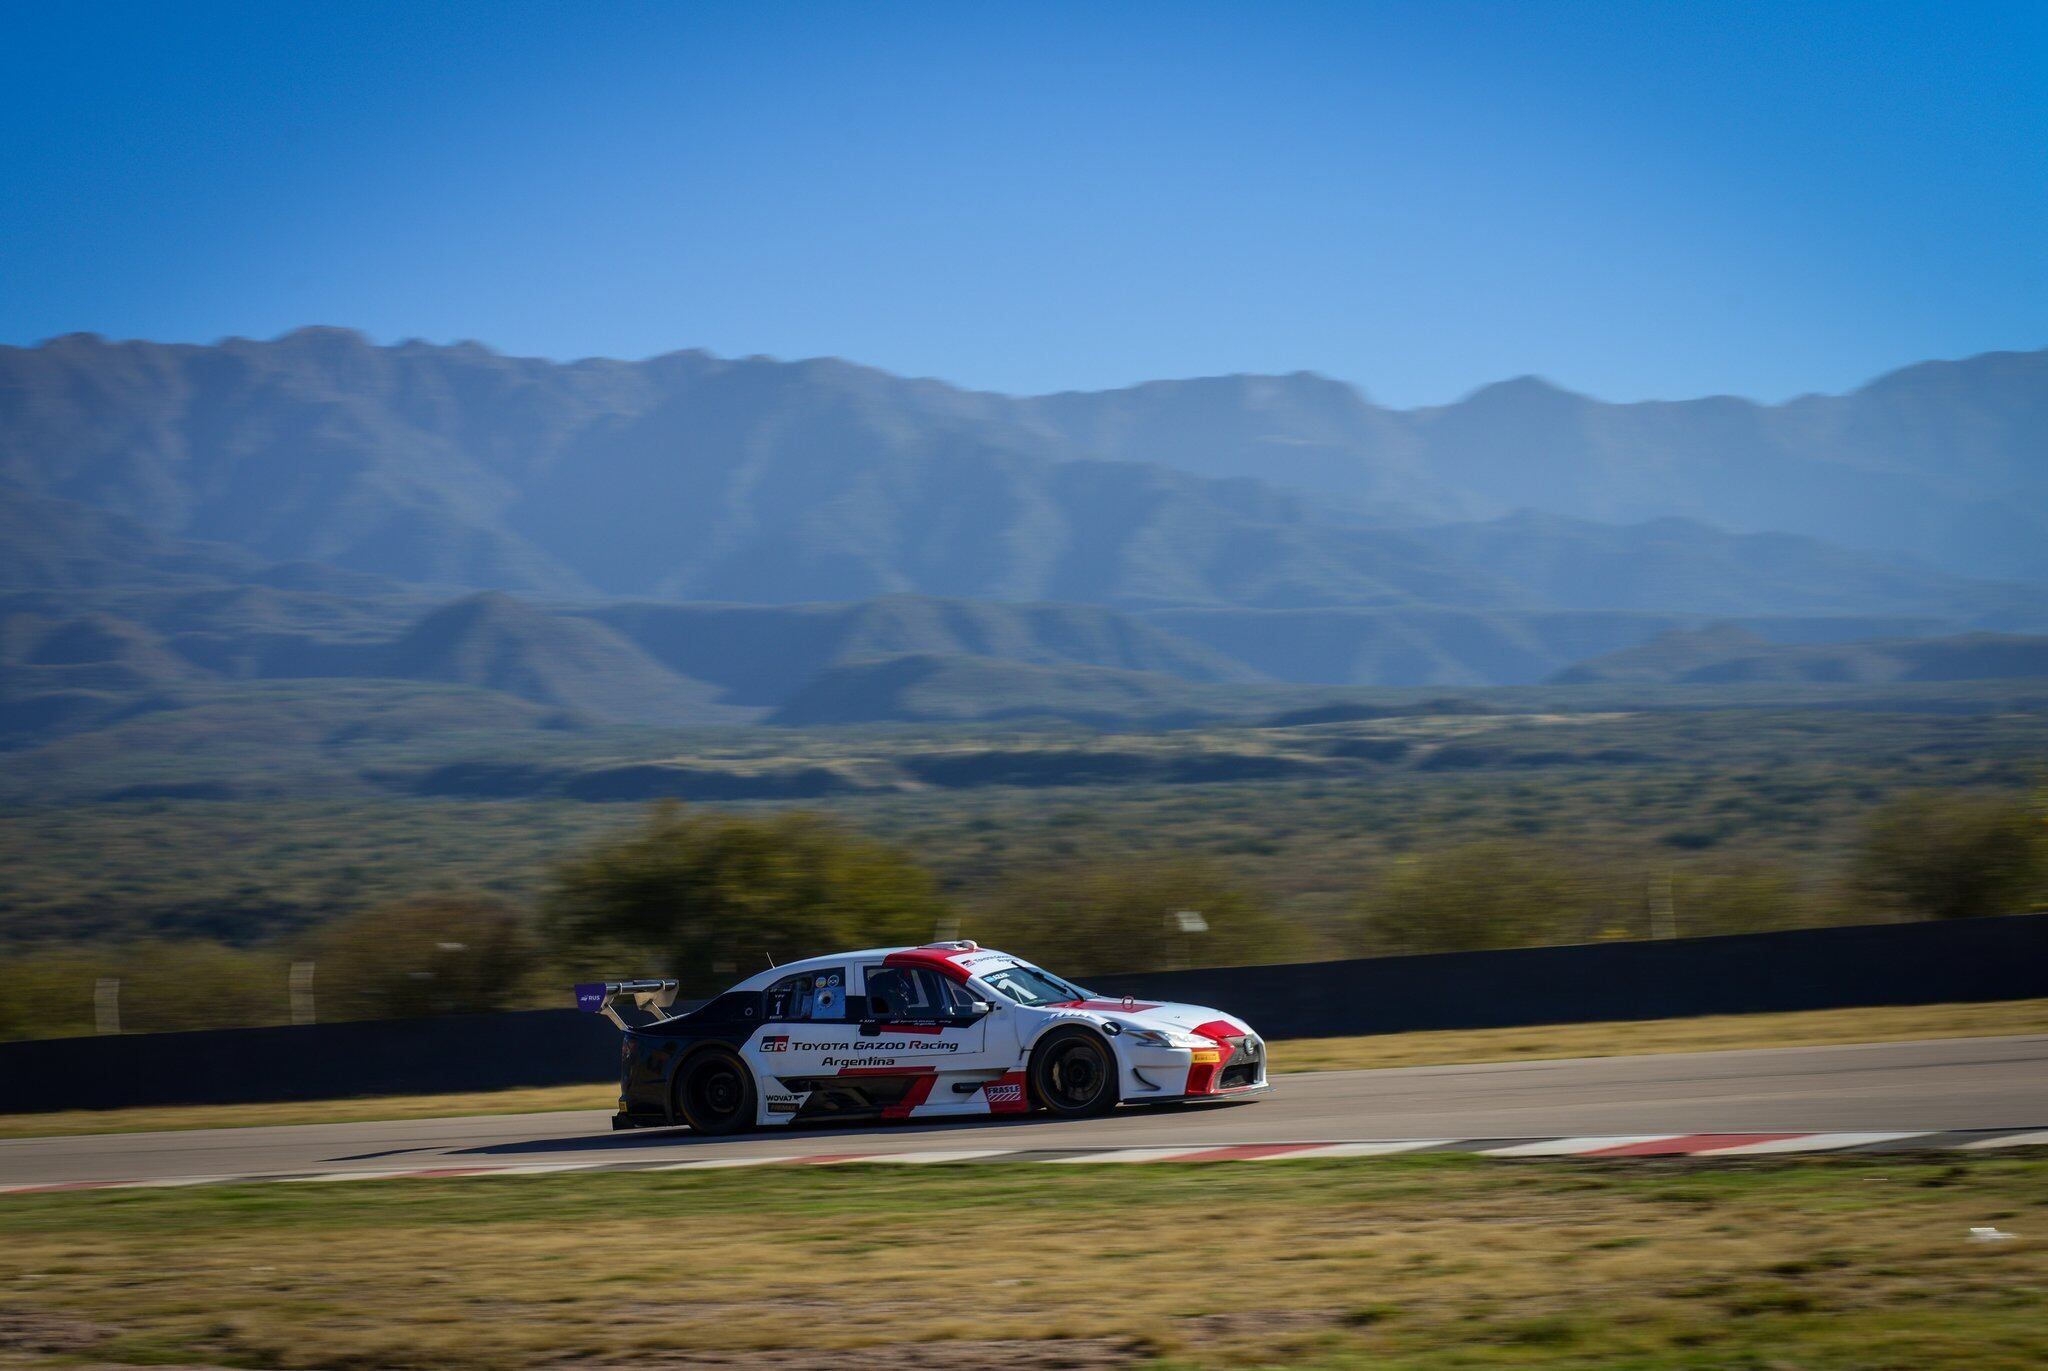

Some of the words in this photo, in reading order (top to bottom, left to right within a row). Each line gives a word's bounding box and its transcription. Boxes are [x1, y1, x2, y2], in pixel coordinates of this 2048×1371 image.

[775, 1000, 781, 1015] 1
[760, 1041, 787, 1052] GR
[791, 1042, 849, 1051] TOYOTA
[853, 1041, 906, 1050] GAZOO
[908, 1040, 959, 1052] Racing
[821, 1056, 895, 1069] Argentina
